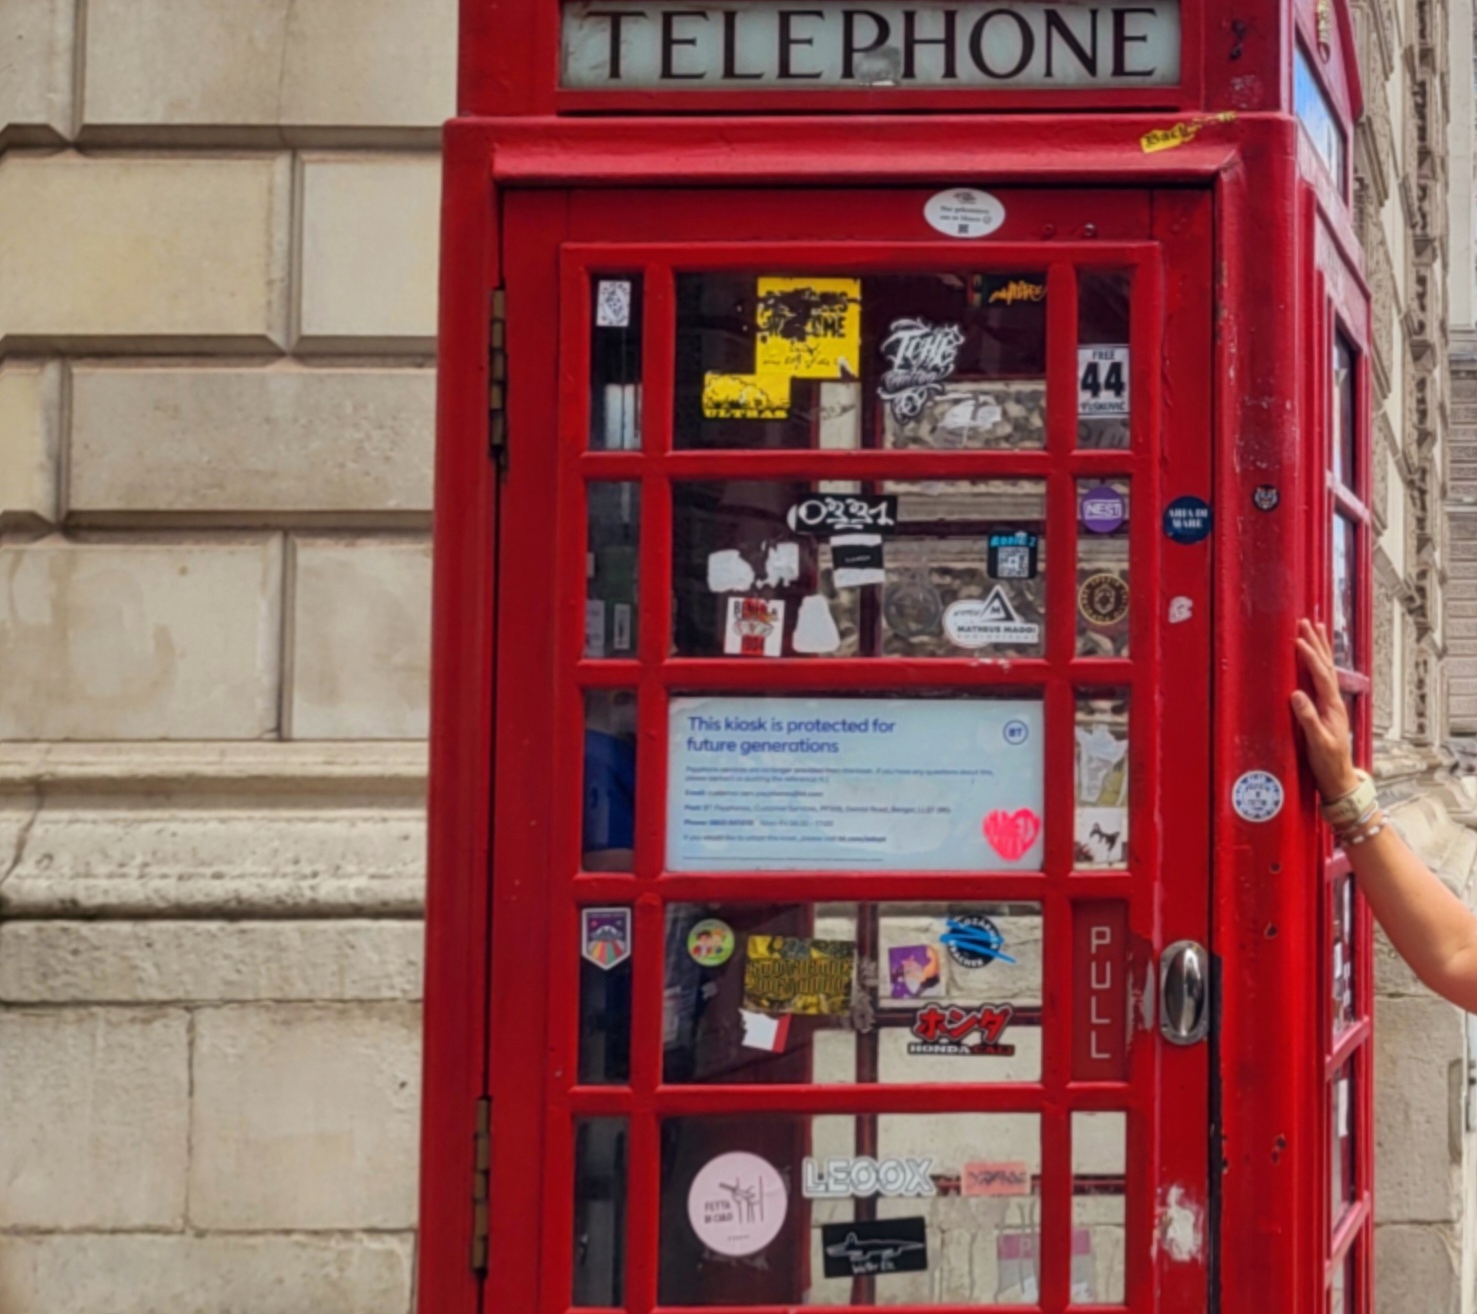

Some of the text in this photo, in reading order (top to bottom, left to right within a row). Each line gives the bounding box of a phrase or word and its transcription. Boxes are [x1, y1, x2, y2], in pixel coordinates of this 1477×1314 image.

[585, 7, 1158, 80] TELEPHONE
[1092, 350, 1116, 361] FREE
[1080, 361, 1126, 399] 44
[703, 408, 789, 419] ULTRAS
[1086, 502, 1122, 518] NEST
[687, 716, 896, 735] This kiosk is protected for
[1008, 727, 1023, 738] BT
[686, 737, 839, 756] future generations
[1090, 926, 1111, 1059] PULL
[909, 1044, 971, 1054] HONDA
